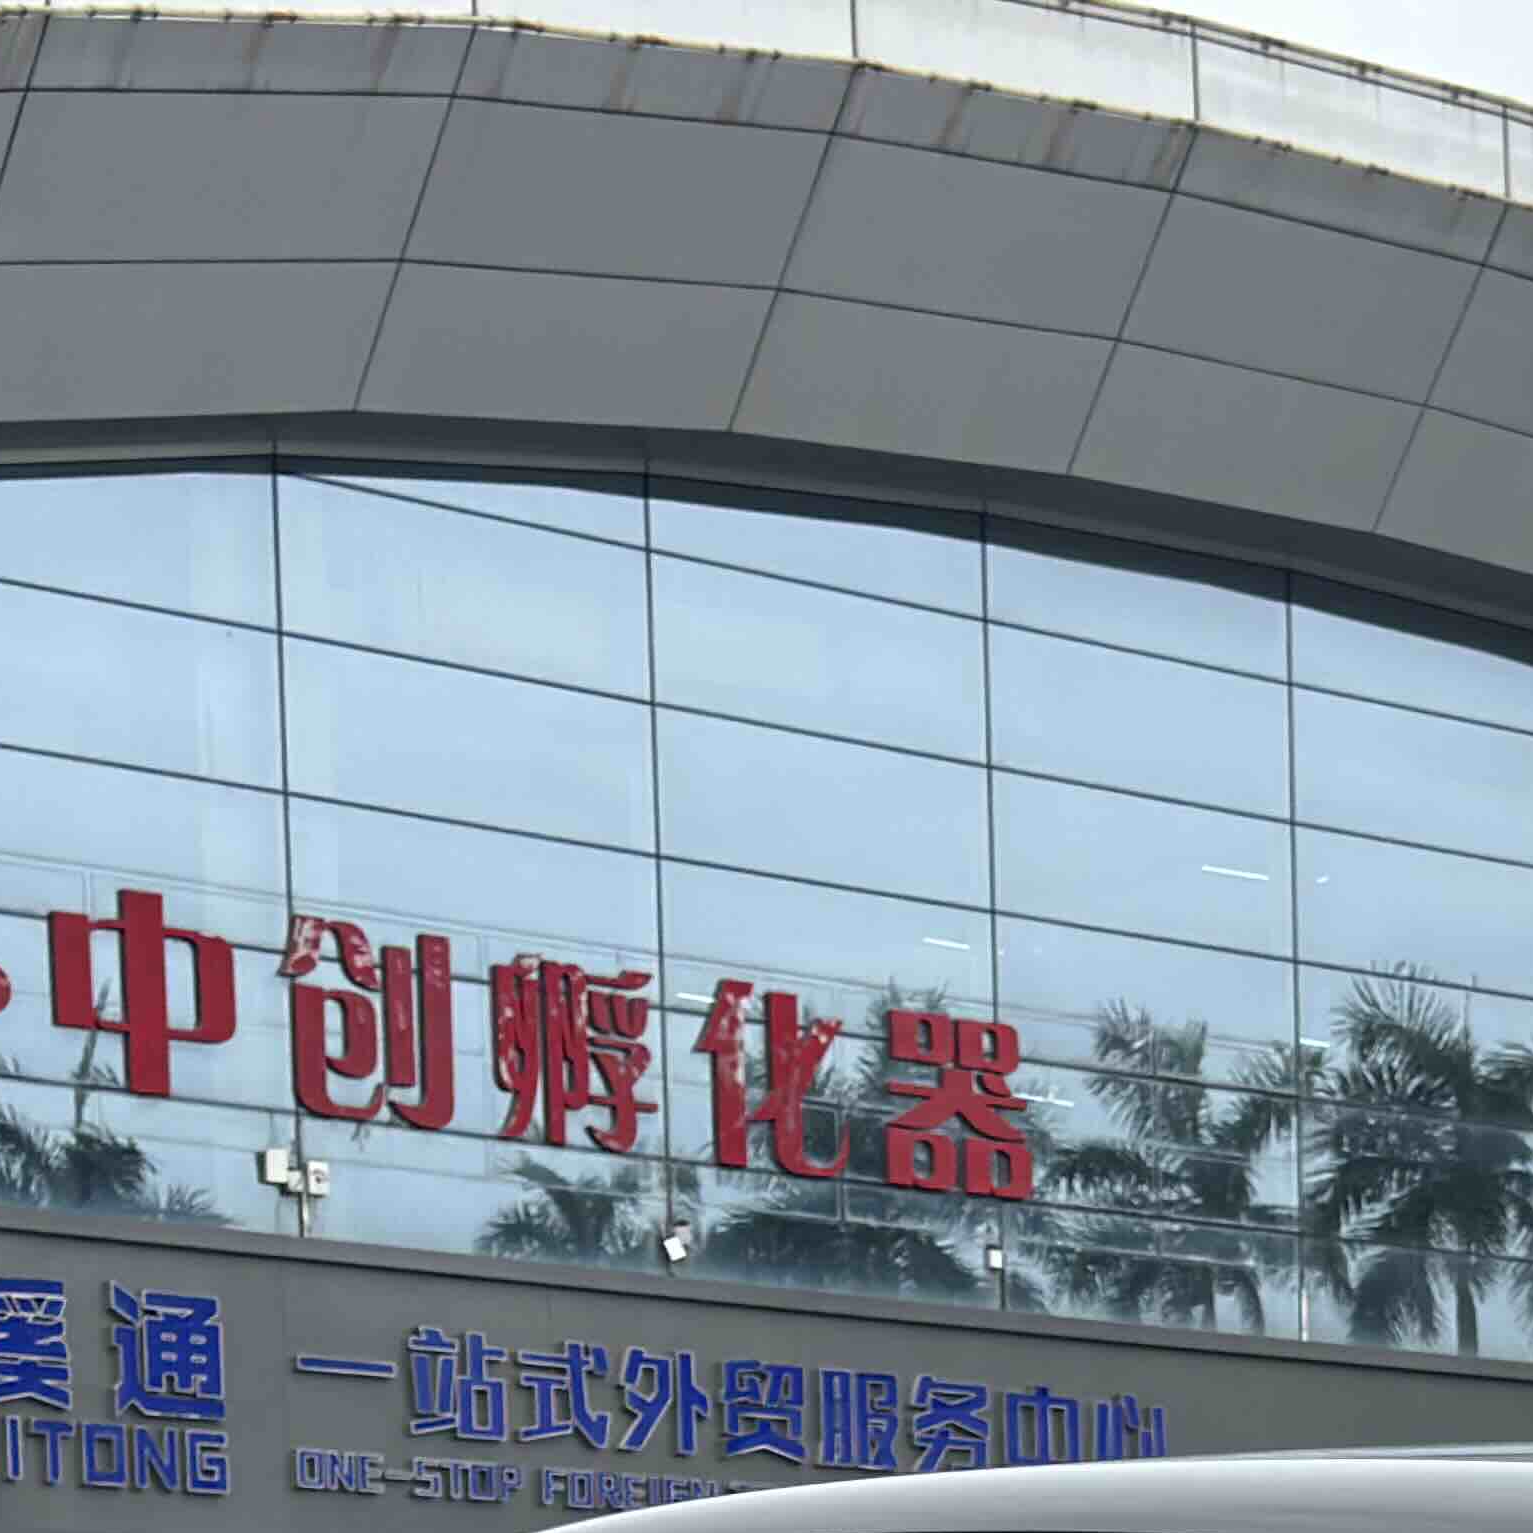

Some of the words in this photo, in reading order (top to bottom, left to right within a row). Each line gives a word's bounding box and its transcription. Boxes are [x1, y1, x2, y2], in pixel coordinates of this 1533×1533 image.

[296, 1328, 1166, 1474] 一站式外贸服务中心
